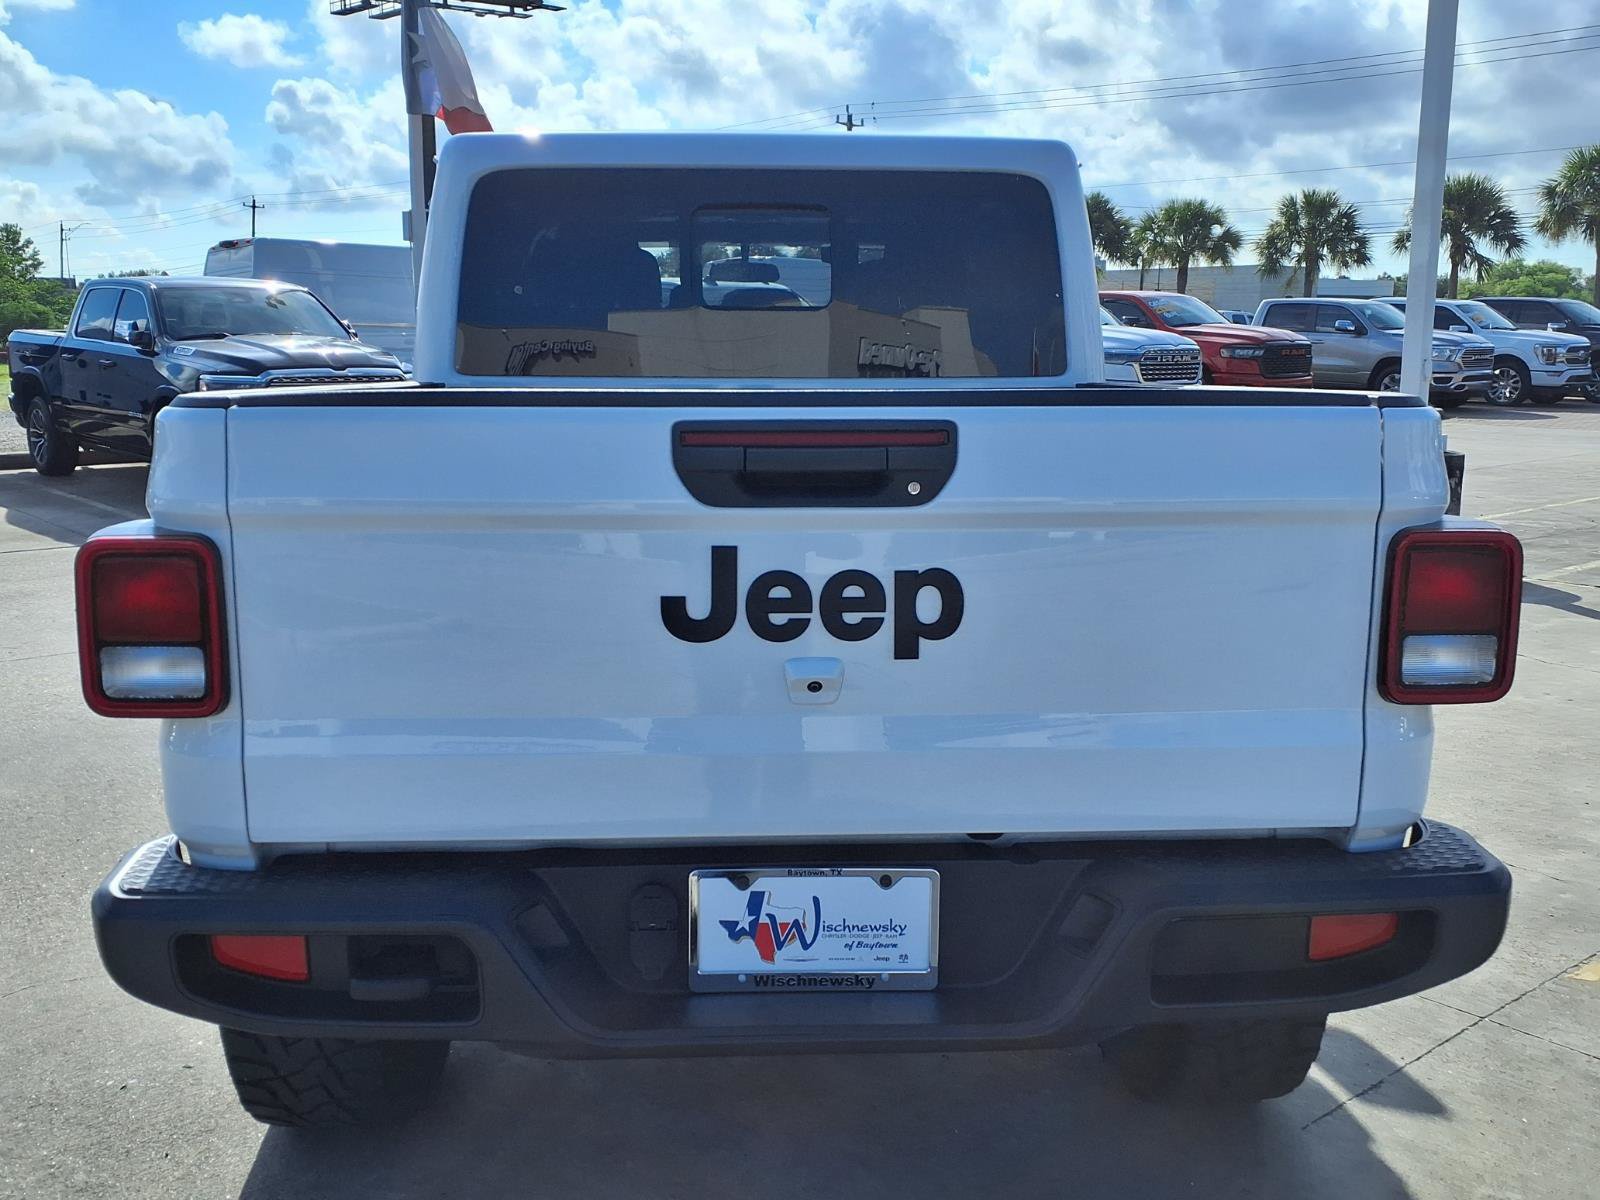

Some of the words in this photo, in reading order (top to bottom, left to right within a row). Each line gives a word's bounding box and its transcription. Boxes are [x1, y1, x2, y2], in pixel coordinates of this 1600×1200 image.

[1162, 354, 1191, 363] RAM
[660, 545, 965, 660] Jeep
[830, 868, 843, 877] TX
[843, 940, 855, 951] of
[855, 940, 899, 951] Baytown
[753, 974, 877, 989] Wischnewsky
